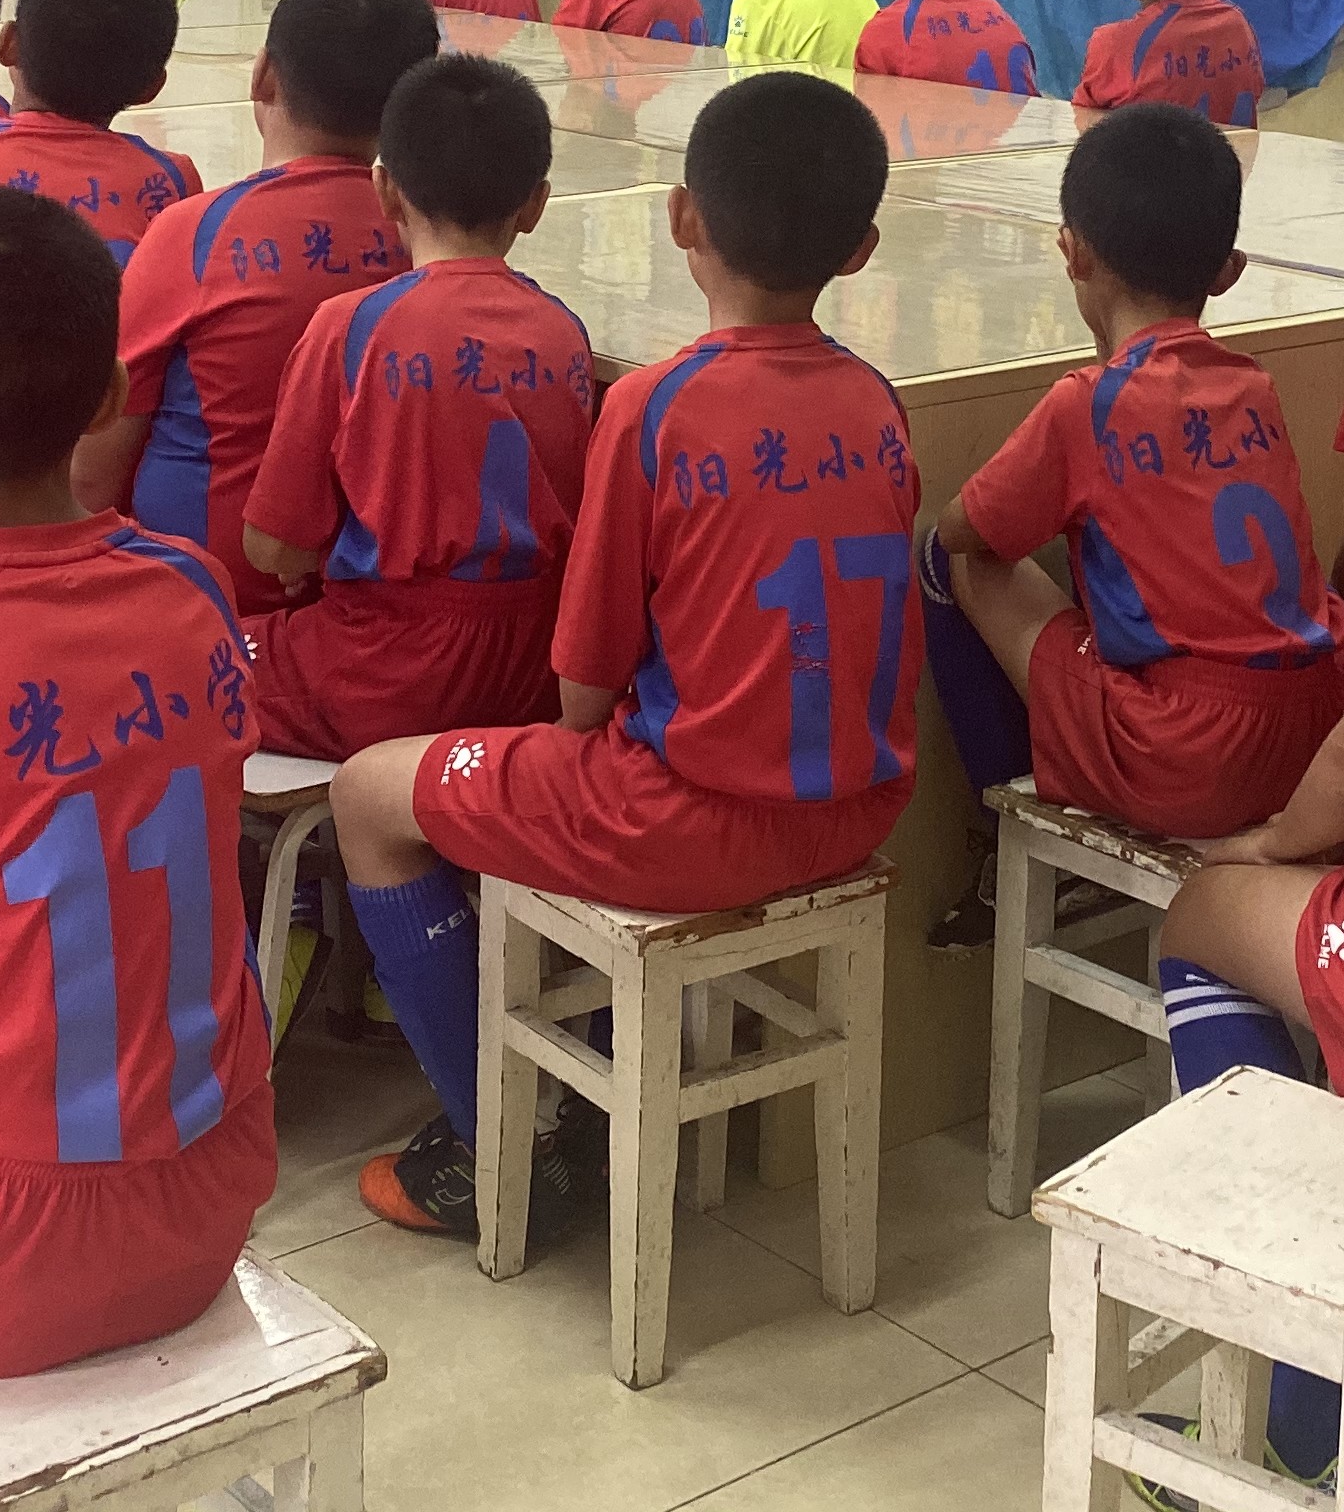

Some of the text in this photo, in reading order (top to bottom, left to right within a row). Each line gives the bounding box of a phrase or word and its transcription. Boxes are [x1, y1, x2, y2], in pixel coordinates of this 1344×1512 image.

[674, 424, 909, 510] 阳光小学
[756, 532, 909, 802] 17
[2, 764, 227, 1164] 11
